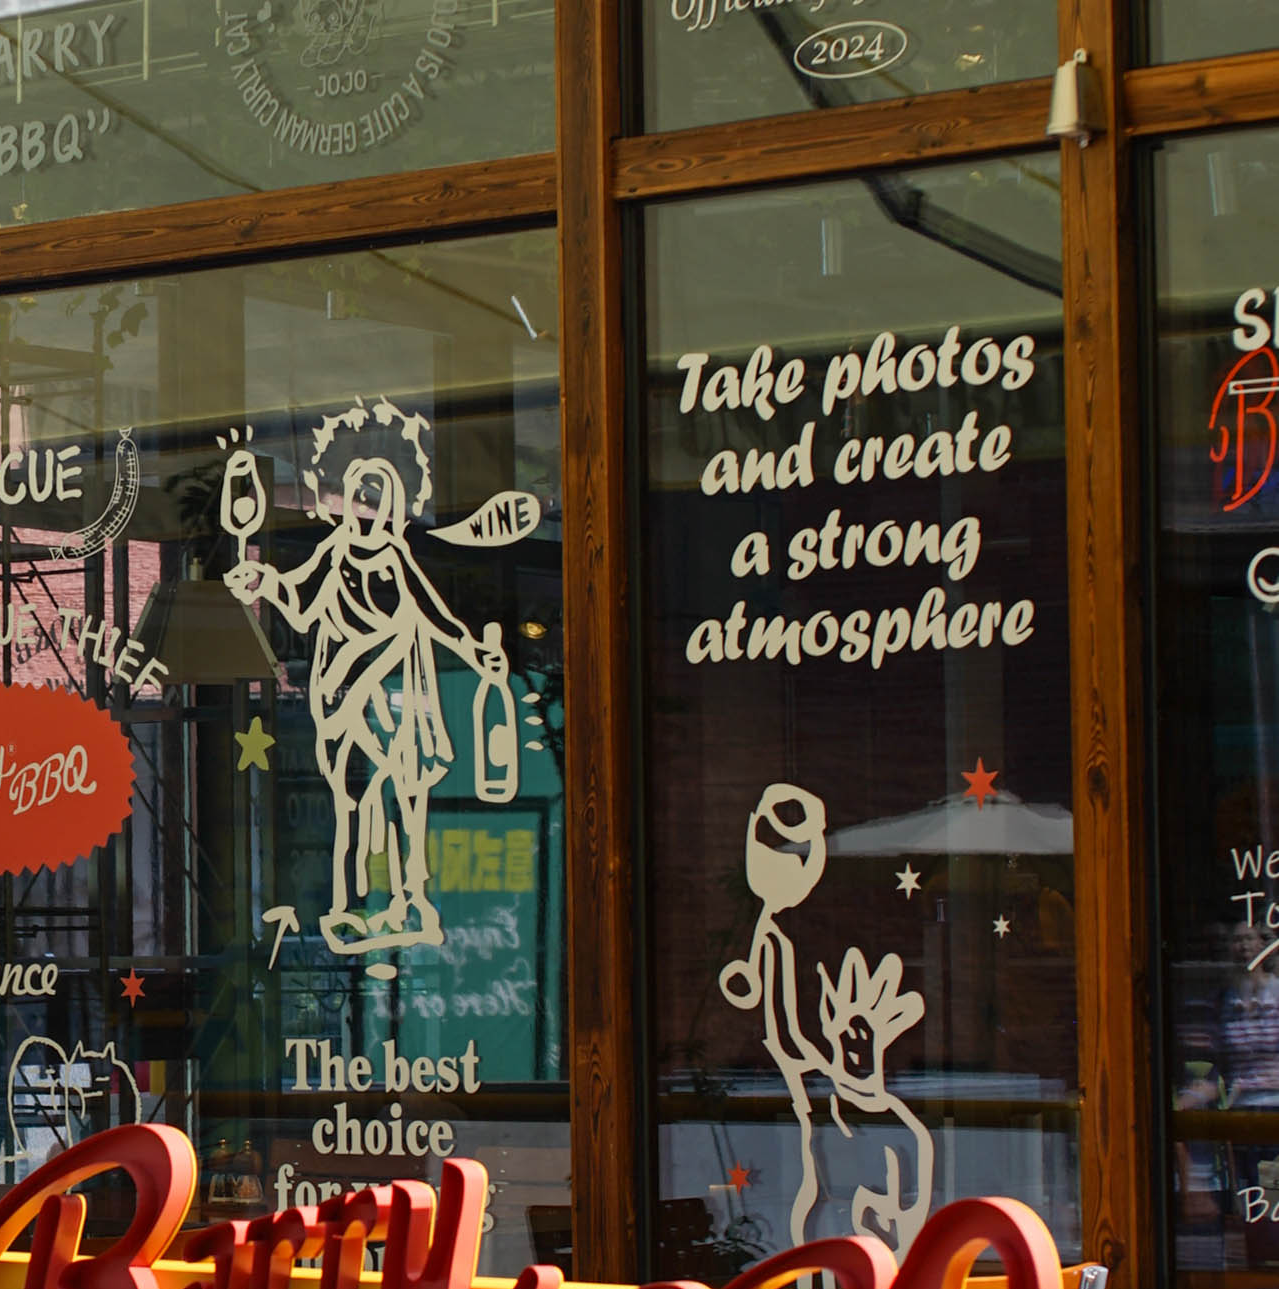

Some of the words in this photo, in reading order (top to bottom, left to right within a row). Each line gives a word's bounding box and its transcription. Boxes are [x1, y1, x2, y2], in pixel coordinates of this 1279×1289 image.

[811, 31, 886, 66] 2024
[314, 70, 368, 97] JOJO
[274, 107, 357, 156] GERMAN
[360, 93, 411, 147] CUTE
[677, 344, 805, 421] Take
[822, 325, 1035, 416] photos
[700, 421, 816, 496] and
[833, 410, 1012, 485] create
[470, 496, 531, 540] WINE
[730, 531, 771, 578] a
[787, 509, 981, 581] strong
[58, 607, 170, 695] THIEF
[686, 586, 1035, 670] atmosphere
[9, 744, 97, 816] BBQ
[285, 1038, 372, 1092] The
[382, 1039, 481, 1094] best
[312, 1102, 454, 1157] choice
